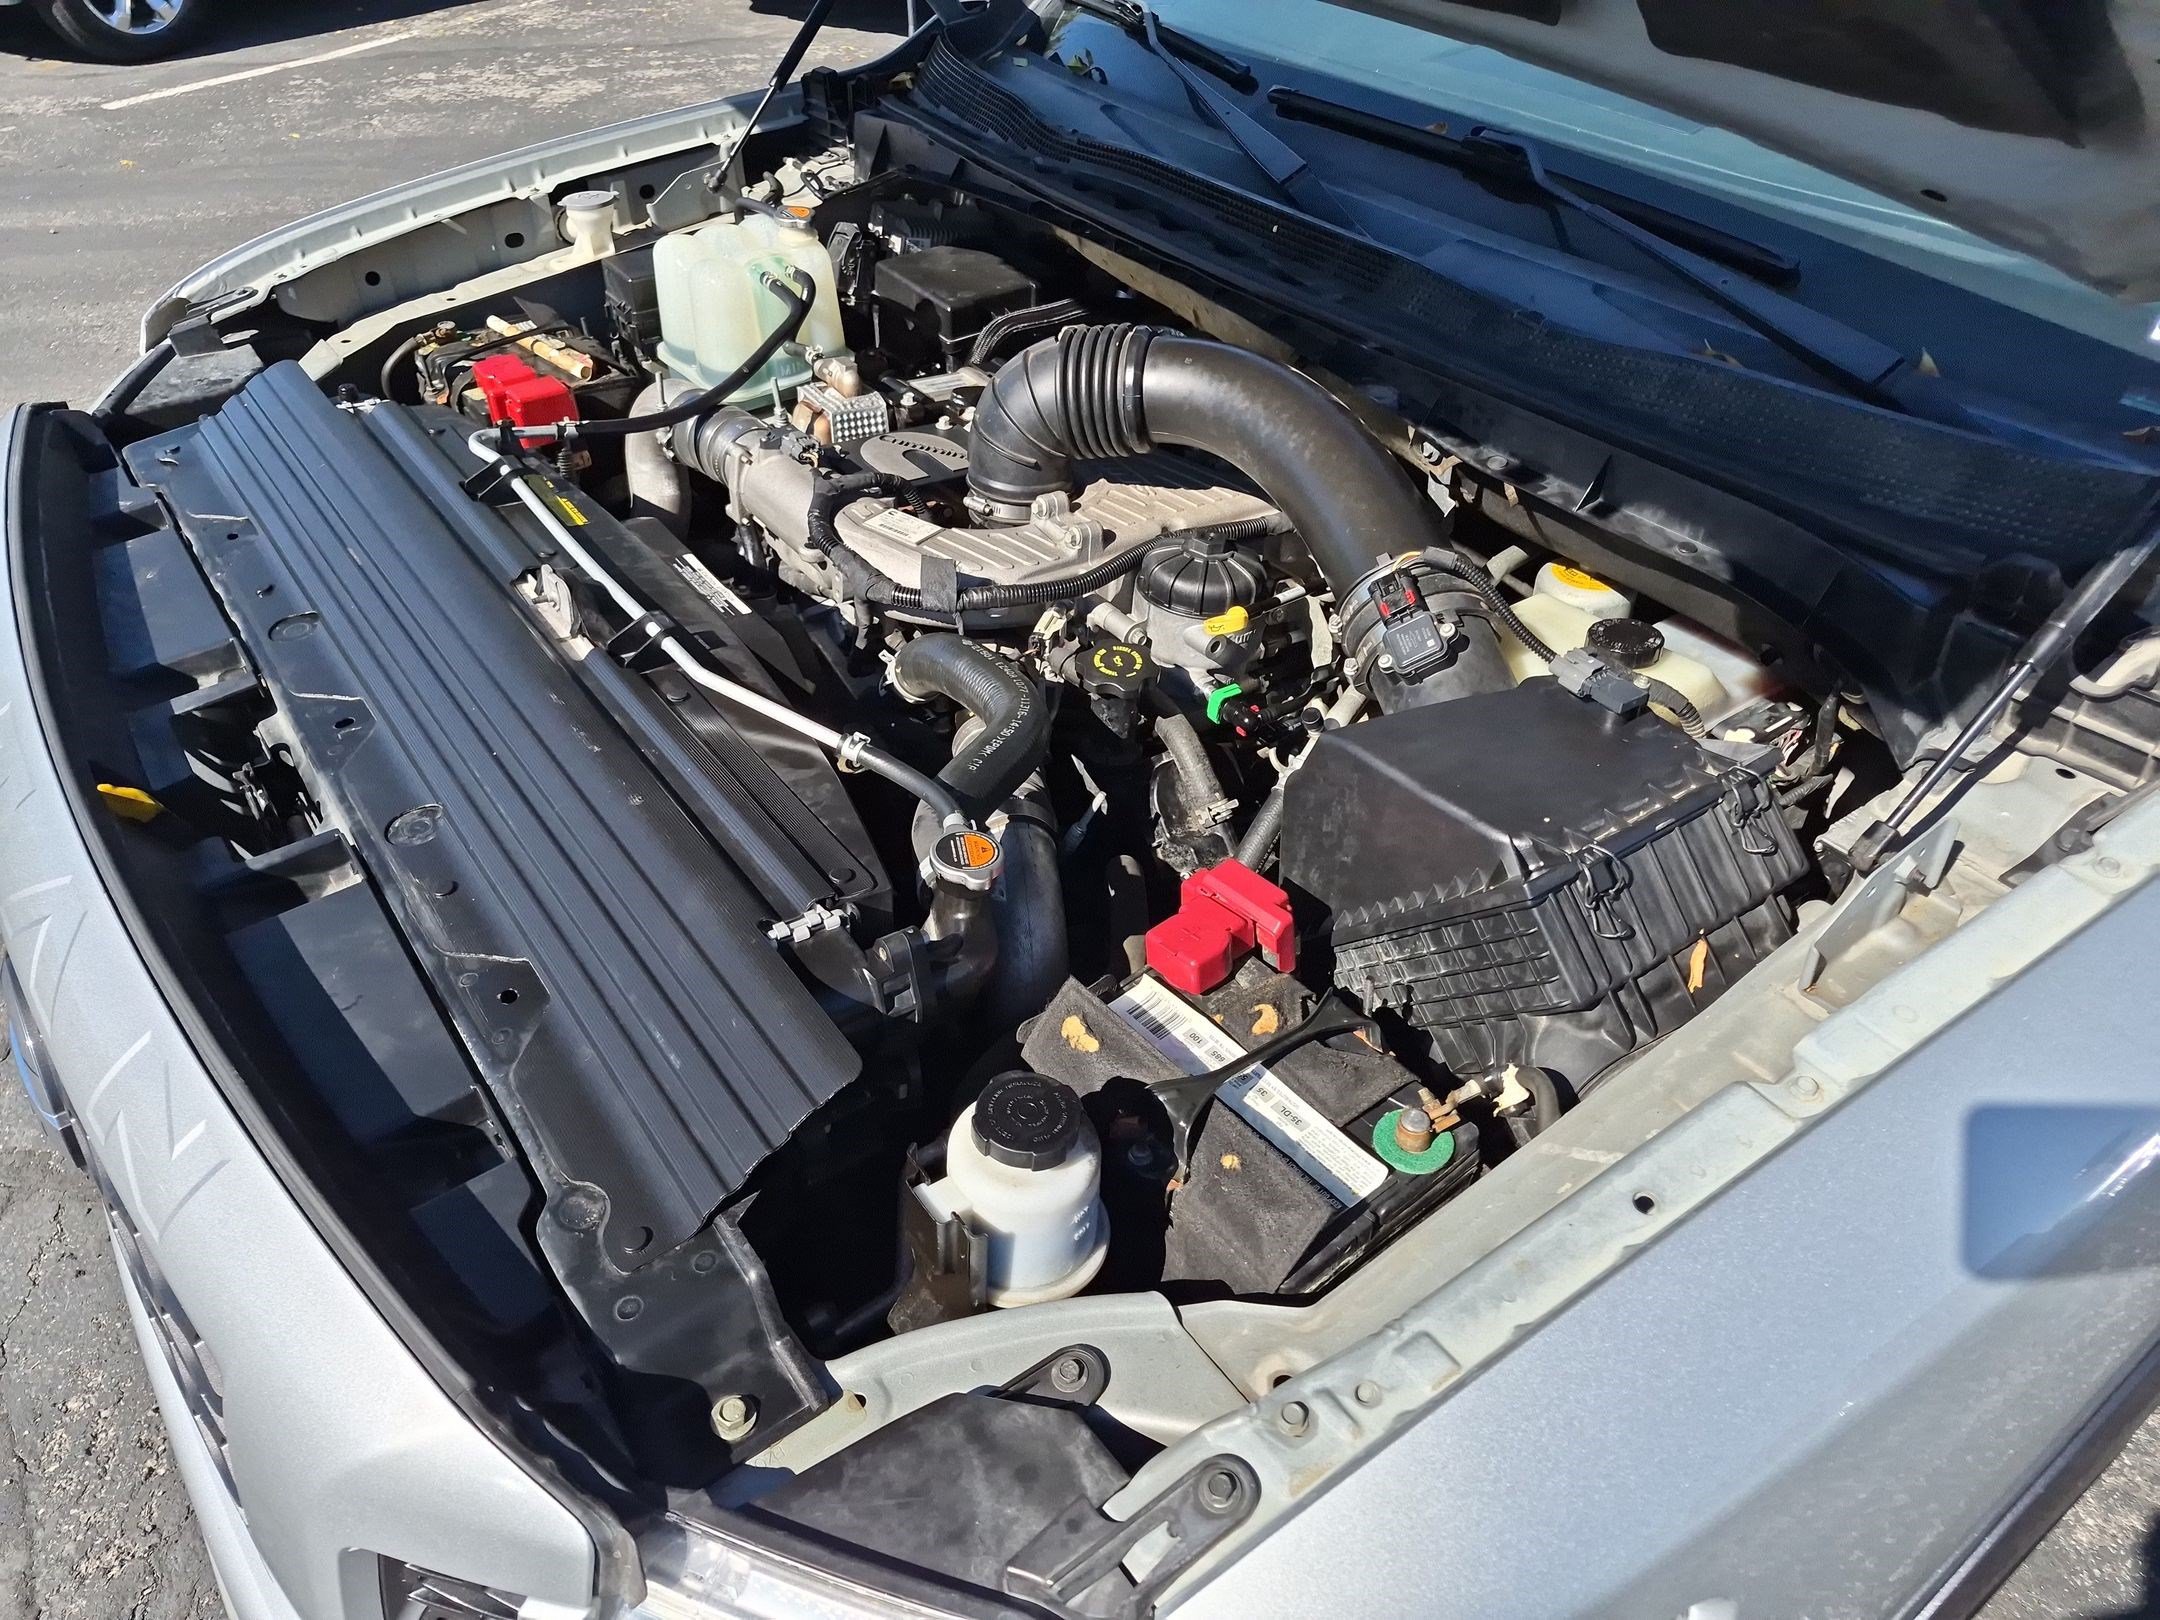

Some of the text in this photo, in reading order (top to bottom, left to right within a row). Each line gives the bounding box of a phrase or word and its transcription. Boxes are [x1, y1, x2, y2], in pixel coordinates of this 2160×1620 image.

[879, 435, 968, 459] Cummin
[1189, 1032, 1203, 1045] 100
[1210, 1050, 1225, 1063] 685
[1256, 1086, 1268, 1098] 35
[1280, 1105, 1303, 1126] 35-DL
